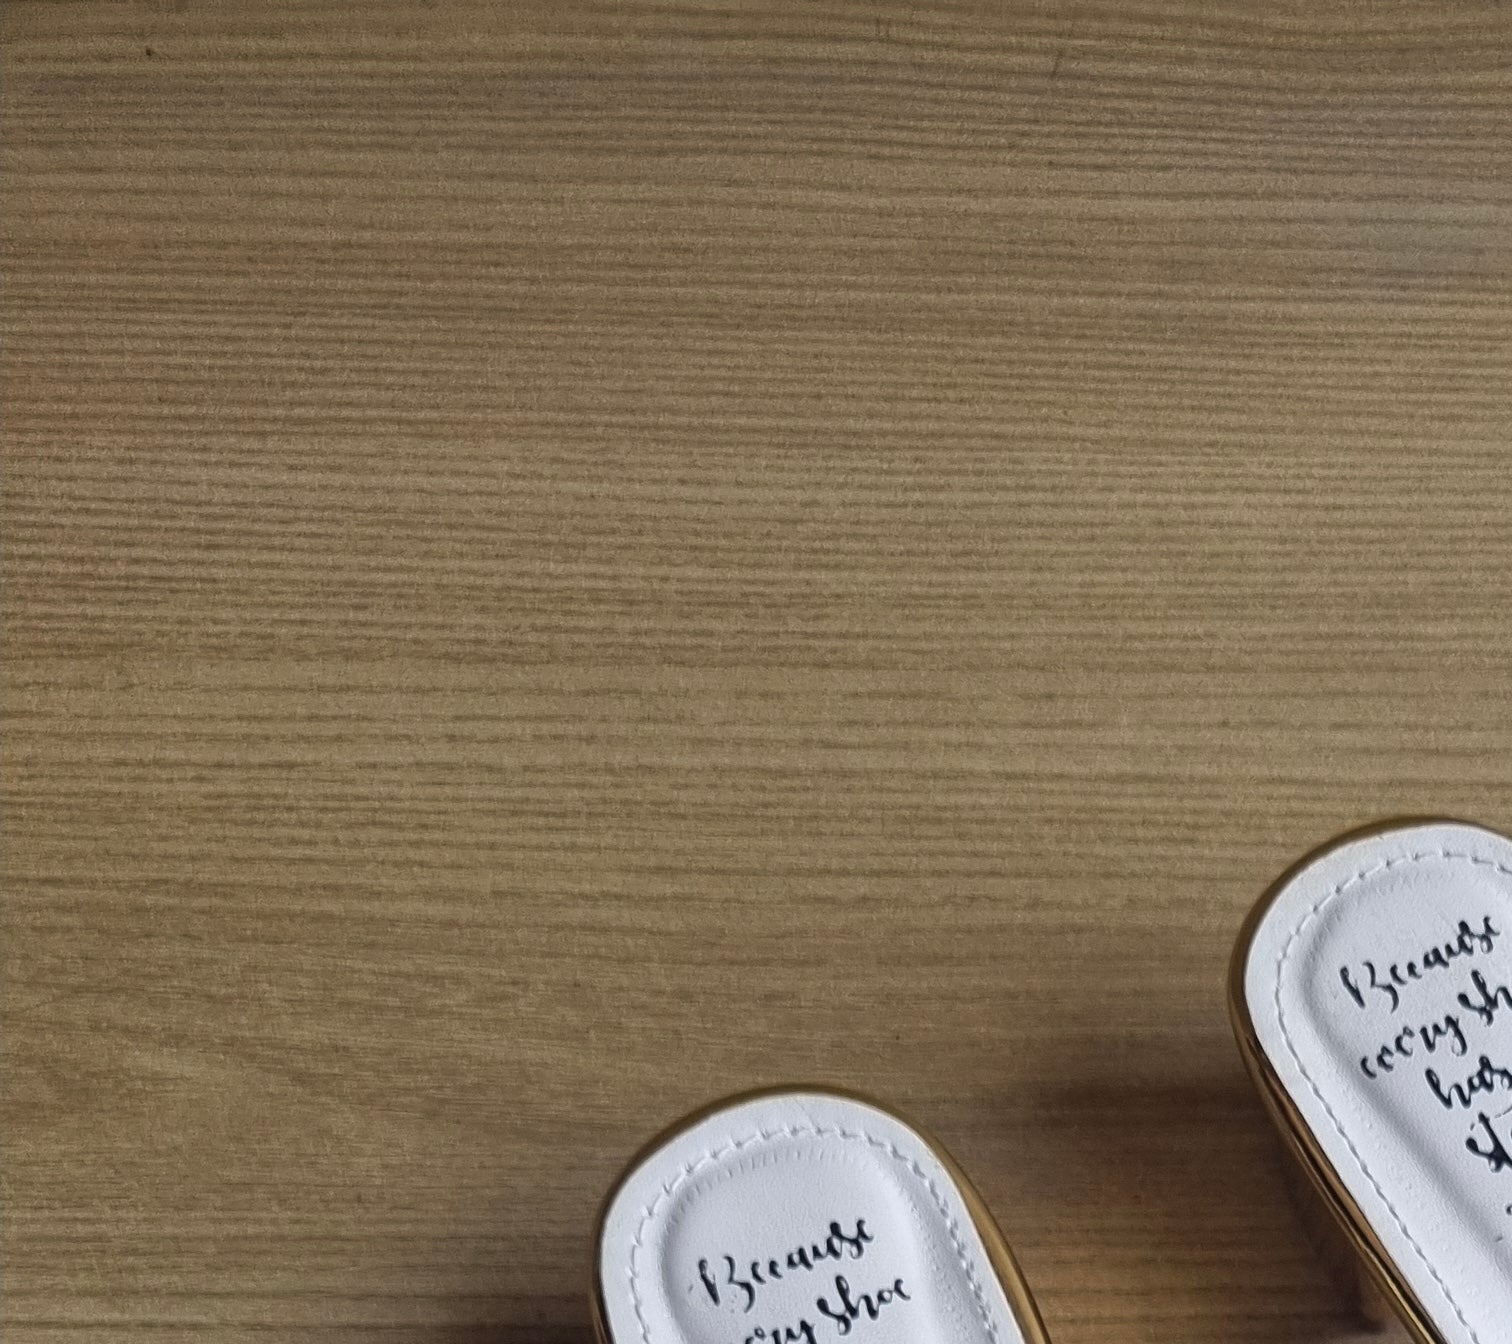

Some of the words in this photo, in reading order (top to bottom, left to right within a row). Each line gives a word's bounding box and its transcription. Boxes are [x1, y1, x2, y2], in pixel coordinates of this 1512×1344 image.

[1339, 915, 1500, 1014] Because
[1359, 1014, 1468, 1079] every
[697, 1217, 874, 1313] Because
[817, 1274, 911, 1337] shoe
